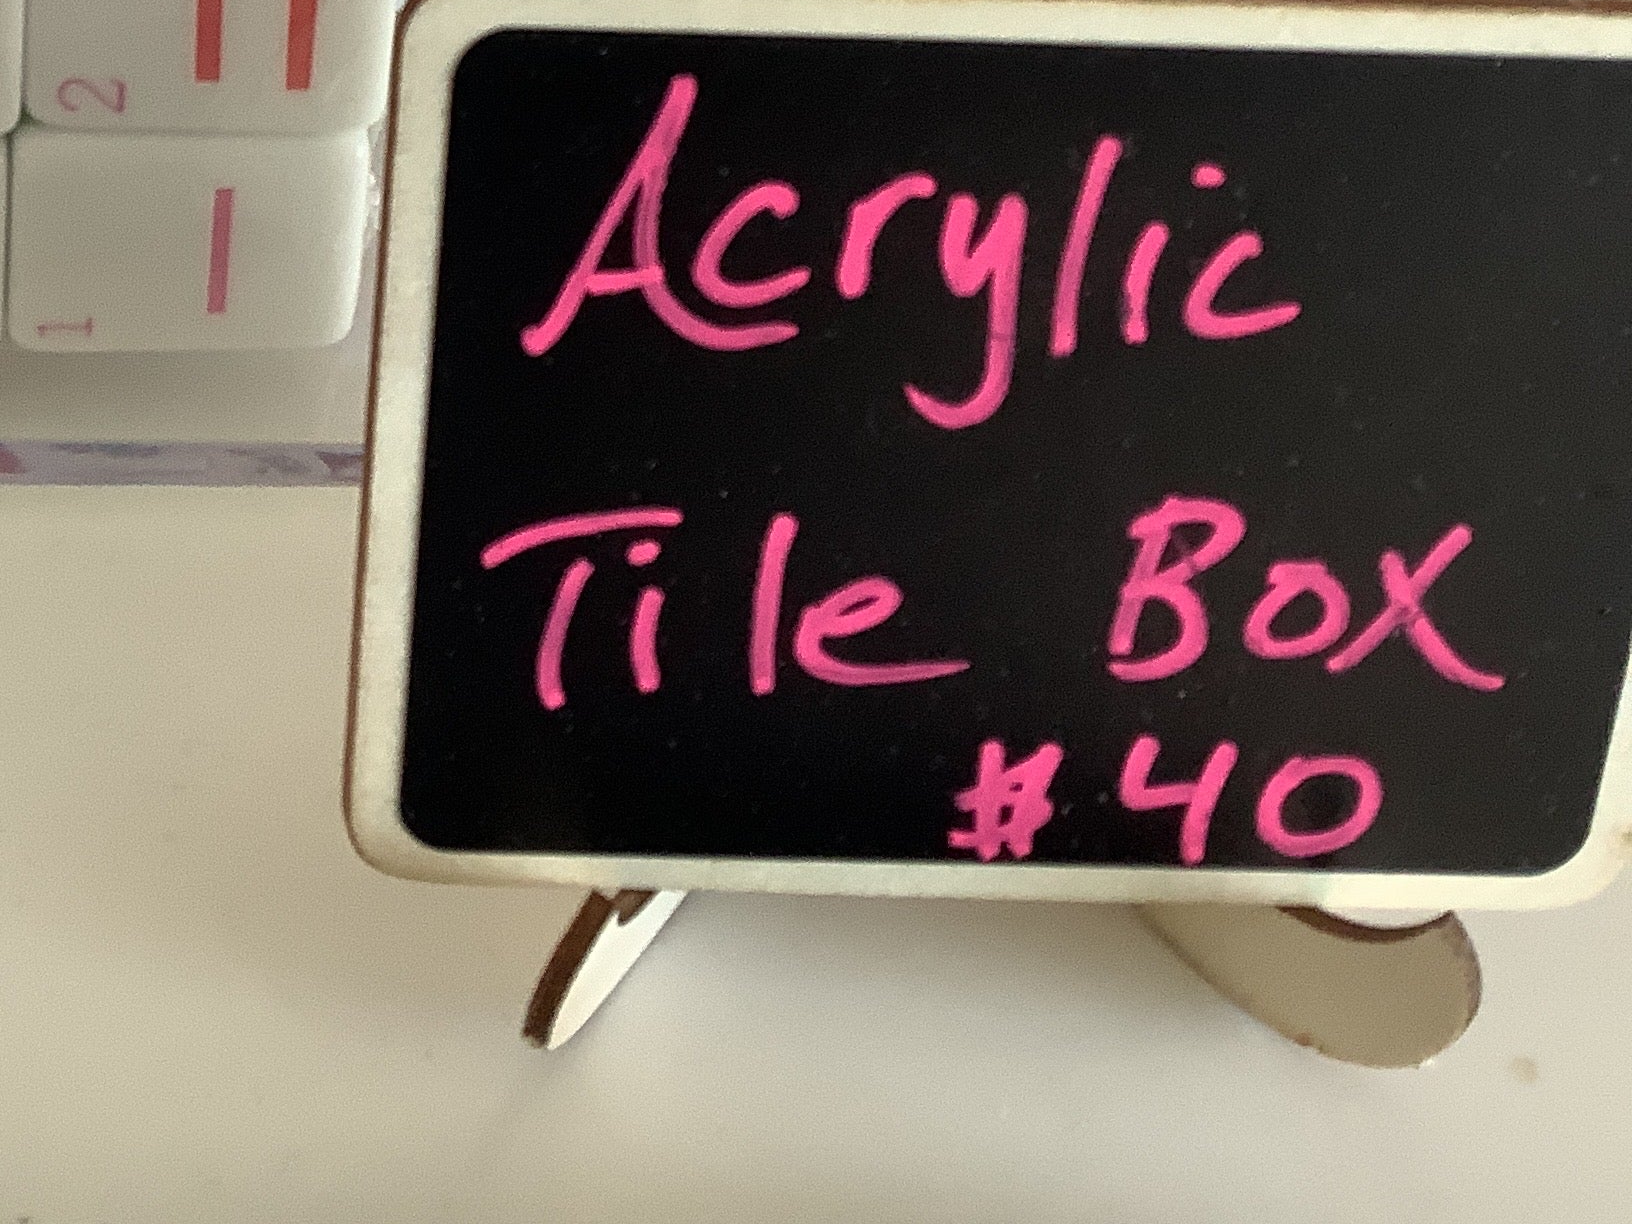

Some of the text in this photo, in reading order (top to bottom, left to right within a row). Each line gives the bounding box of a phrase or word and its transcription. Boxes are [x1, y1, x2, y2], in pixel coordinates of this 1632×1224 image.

[57, 77, 127, 114] 2
[522, 75, 1301, 429] Acrylic
[36, 317, 94, 337] 1
[481, 495, 1505, 711] Tile Box
